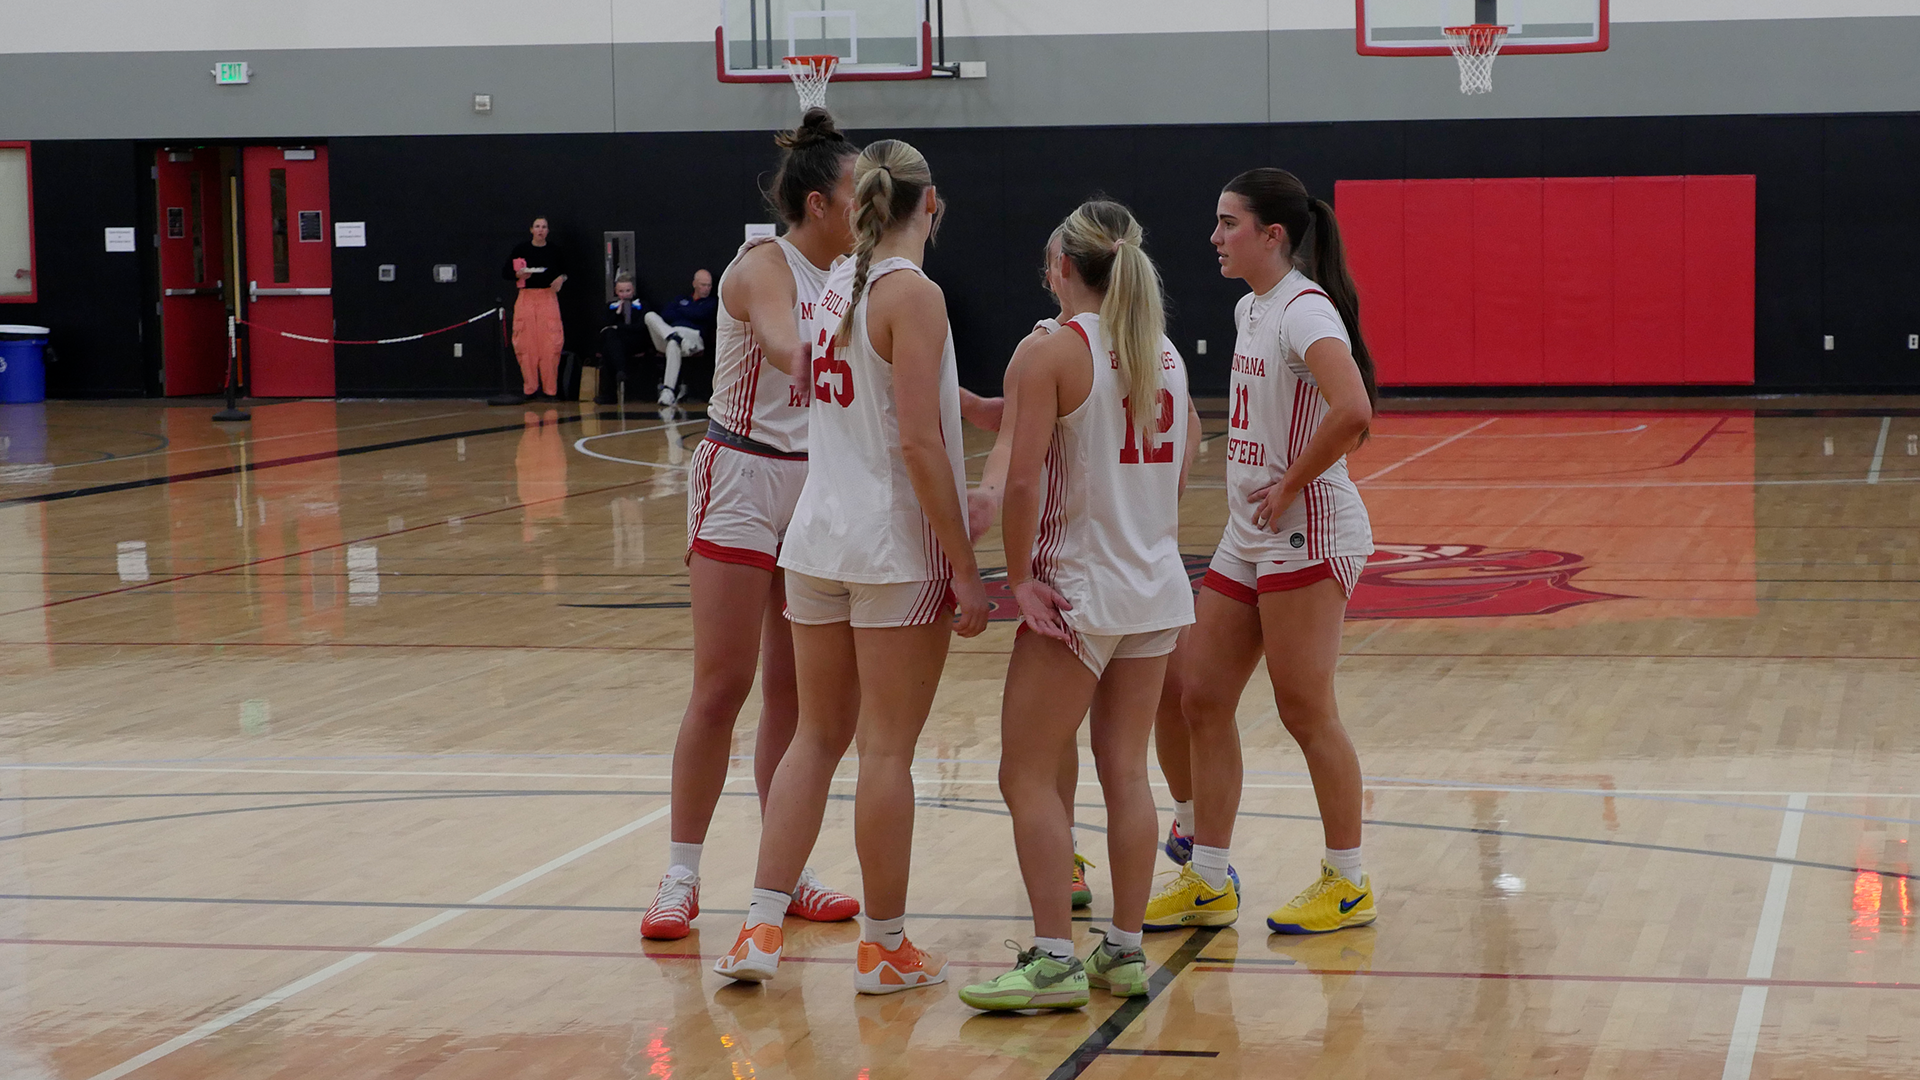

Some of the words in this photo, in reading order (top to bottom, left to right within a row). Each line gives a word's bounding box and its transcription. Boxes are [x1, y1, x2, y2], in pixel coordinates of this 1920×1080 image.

[221, 63, 242, 81] EXIT
[821, 289, 851, 319] BULL
[813, 327, 855, 408] 25
[1119, 388, 1174, 464] 12
[1231, 382, 1249, 430] 11
